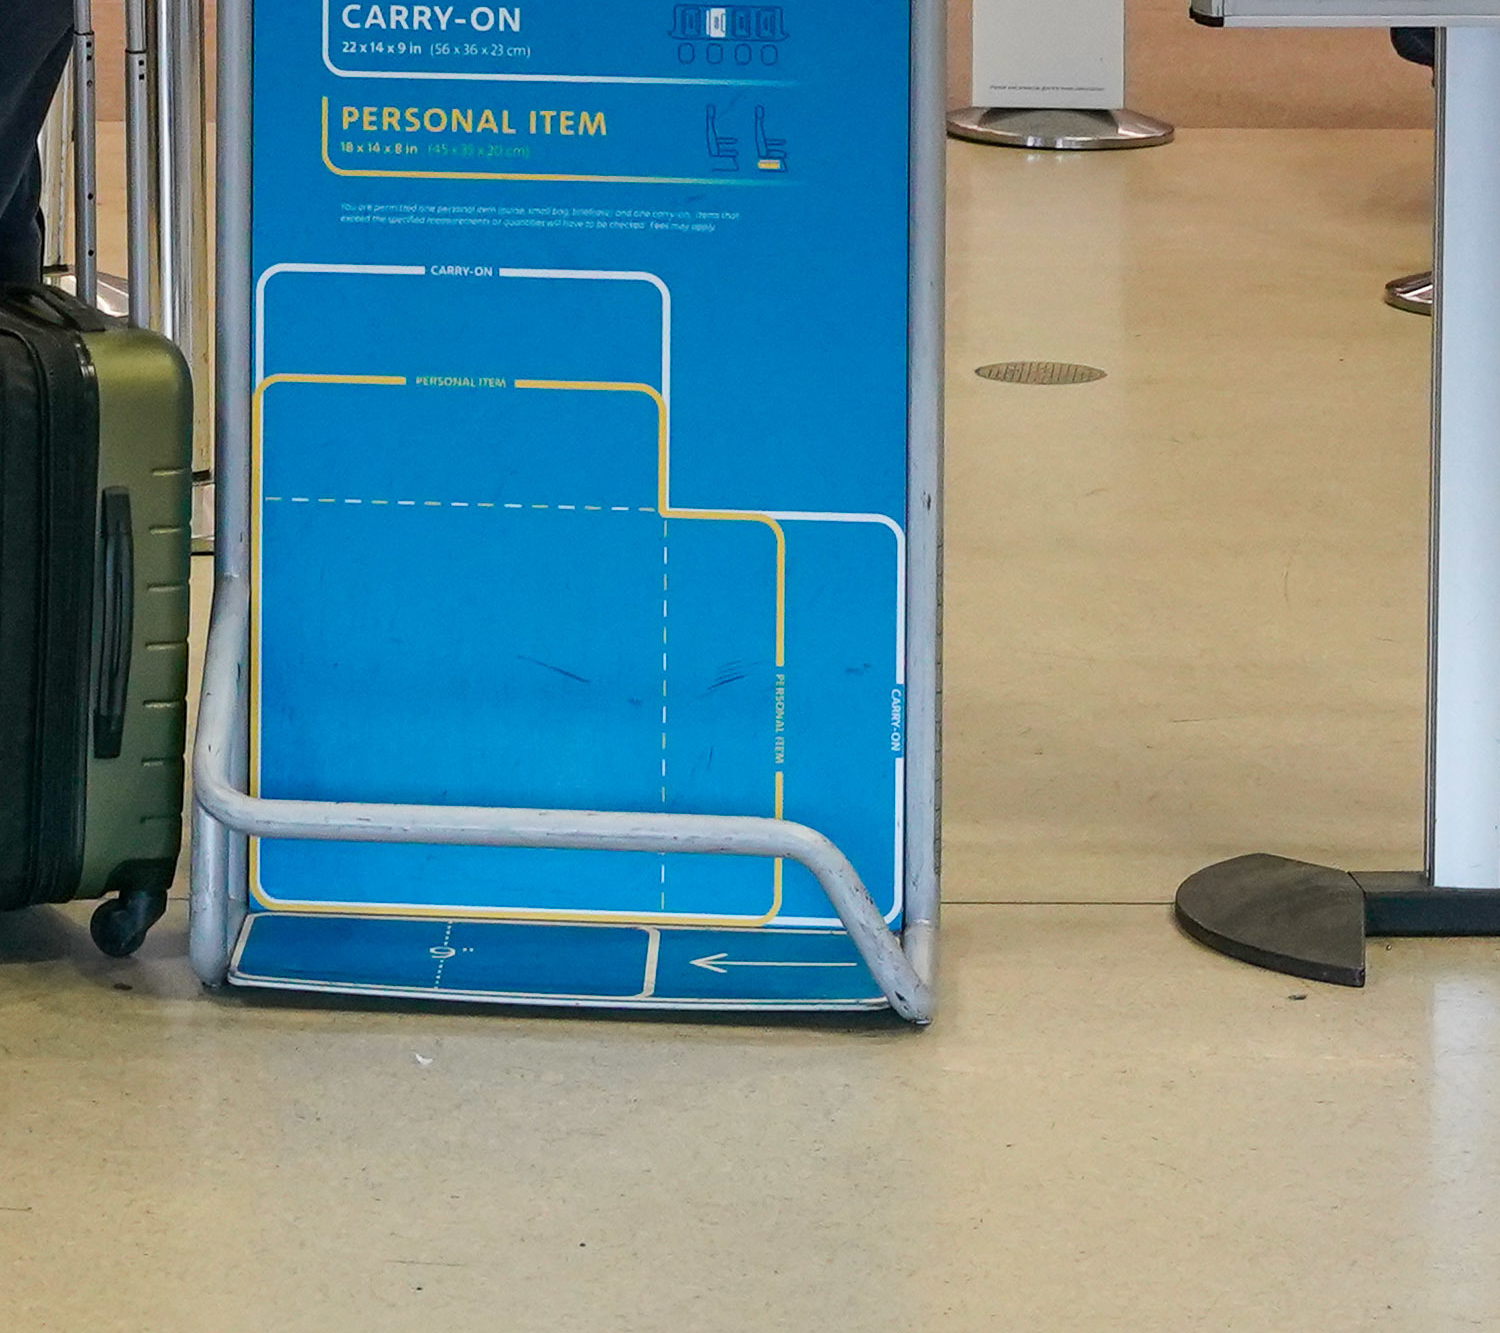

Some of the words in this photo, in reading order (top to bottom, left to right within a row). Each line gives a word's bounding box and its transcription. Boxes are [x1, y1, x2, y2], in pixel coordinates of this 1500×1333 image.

[341, 4, 520, 32] CARRY-ON
[342, 41, 356, 53] 22
[370, 41, 384, 53] 14
[397, 41, 406, 54] 9
[409, 42, 421, 54] in
[430, 43, 450, 56] (56
[464, 43, 478, 55] 36
[490, 43, 503, 56] 23
[506, 44, 531, 58] cm)
[341, 106, 516, 134] PERSONAL
[529, 110, 606, 136] ITEM
[430, 265, 493, 277] CARRY-ON
[415, 376, 475, 387] PERSONAL
[478, 377, 506, 388] ITEM
[891, 689, 902, 752] CARRY-ON
